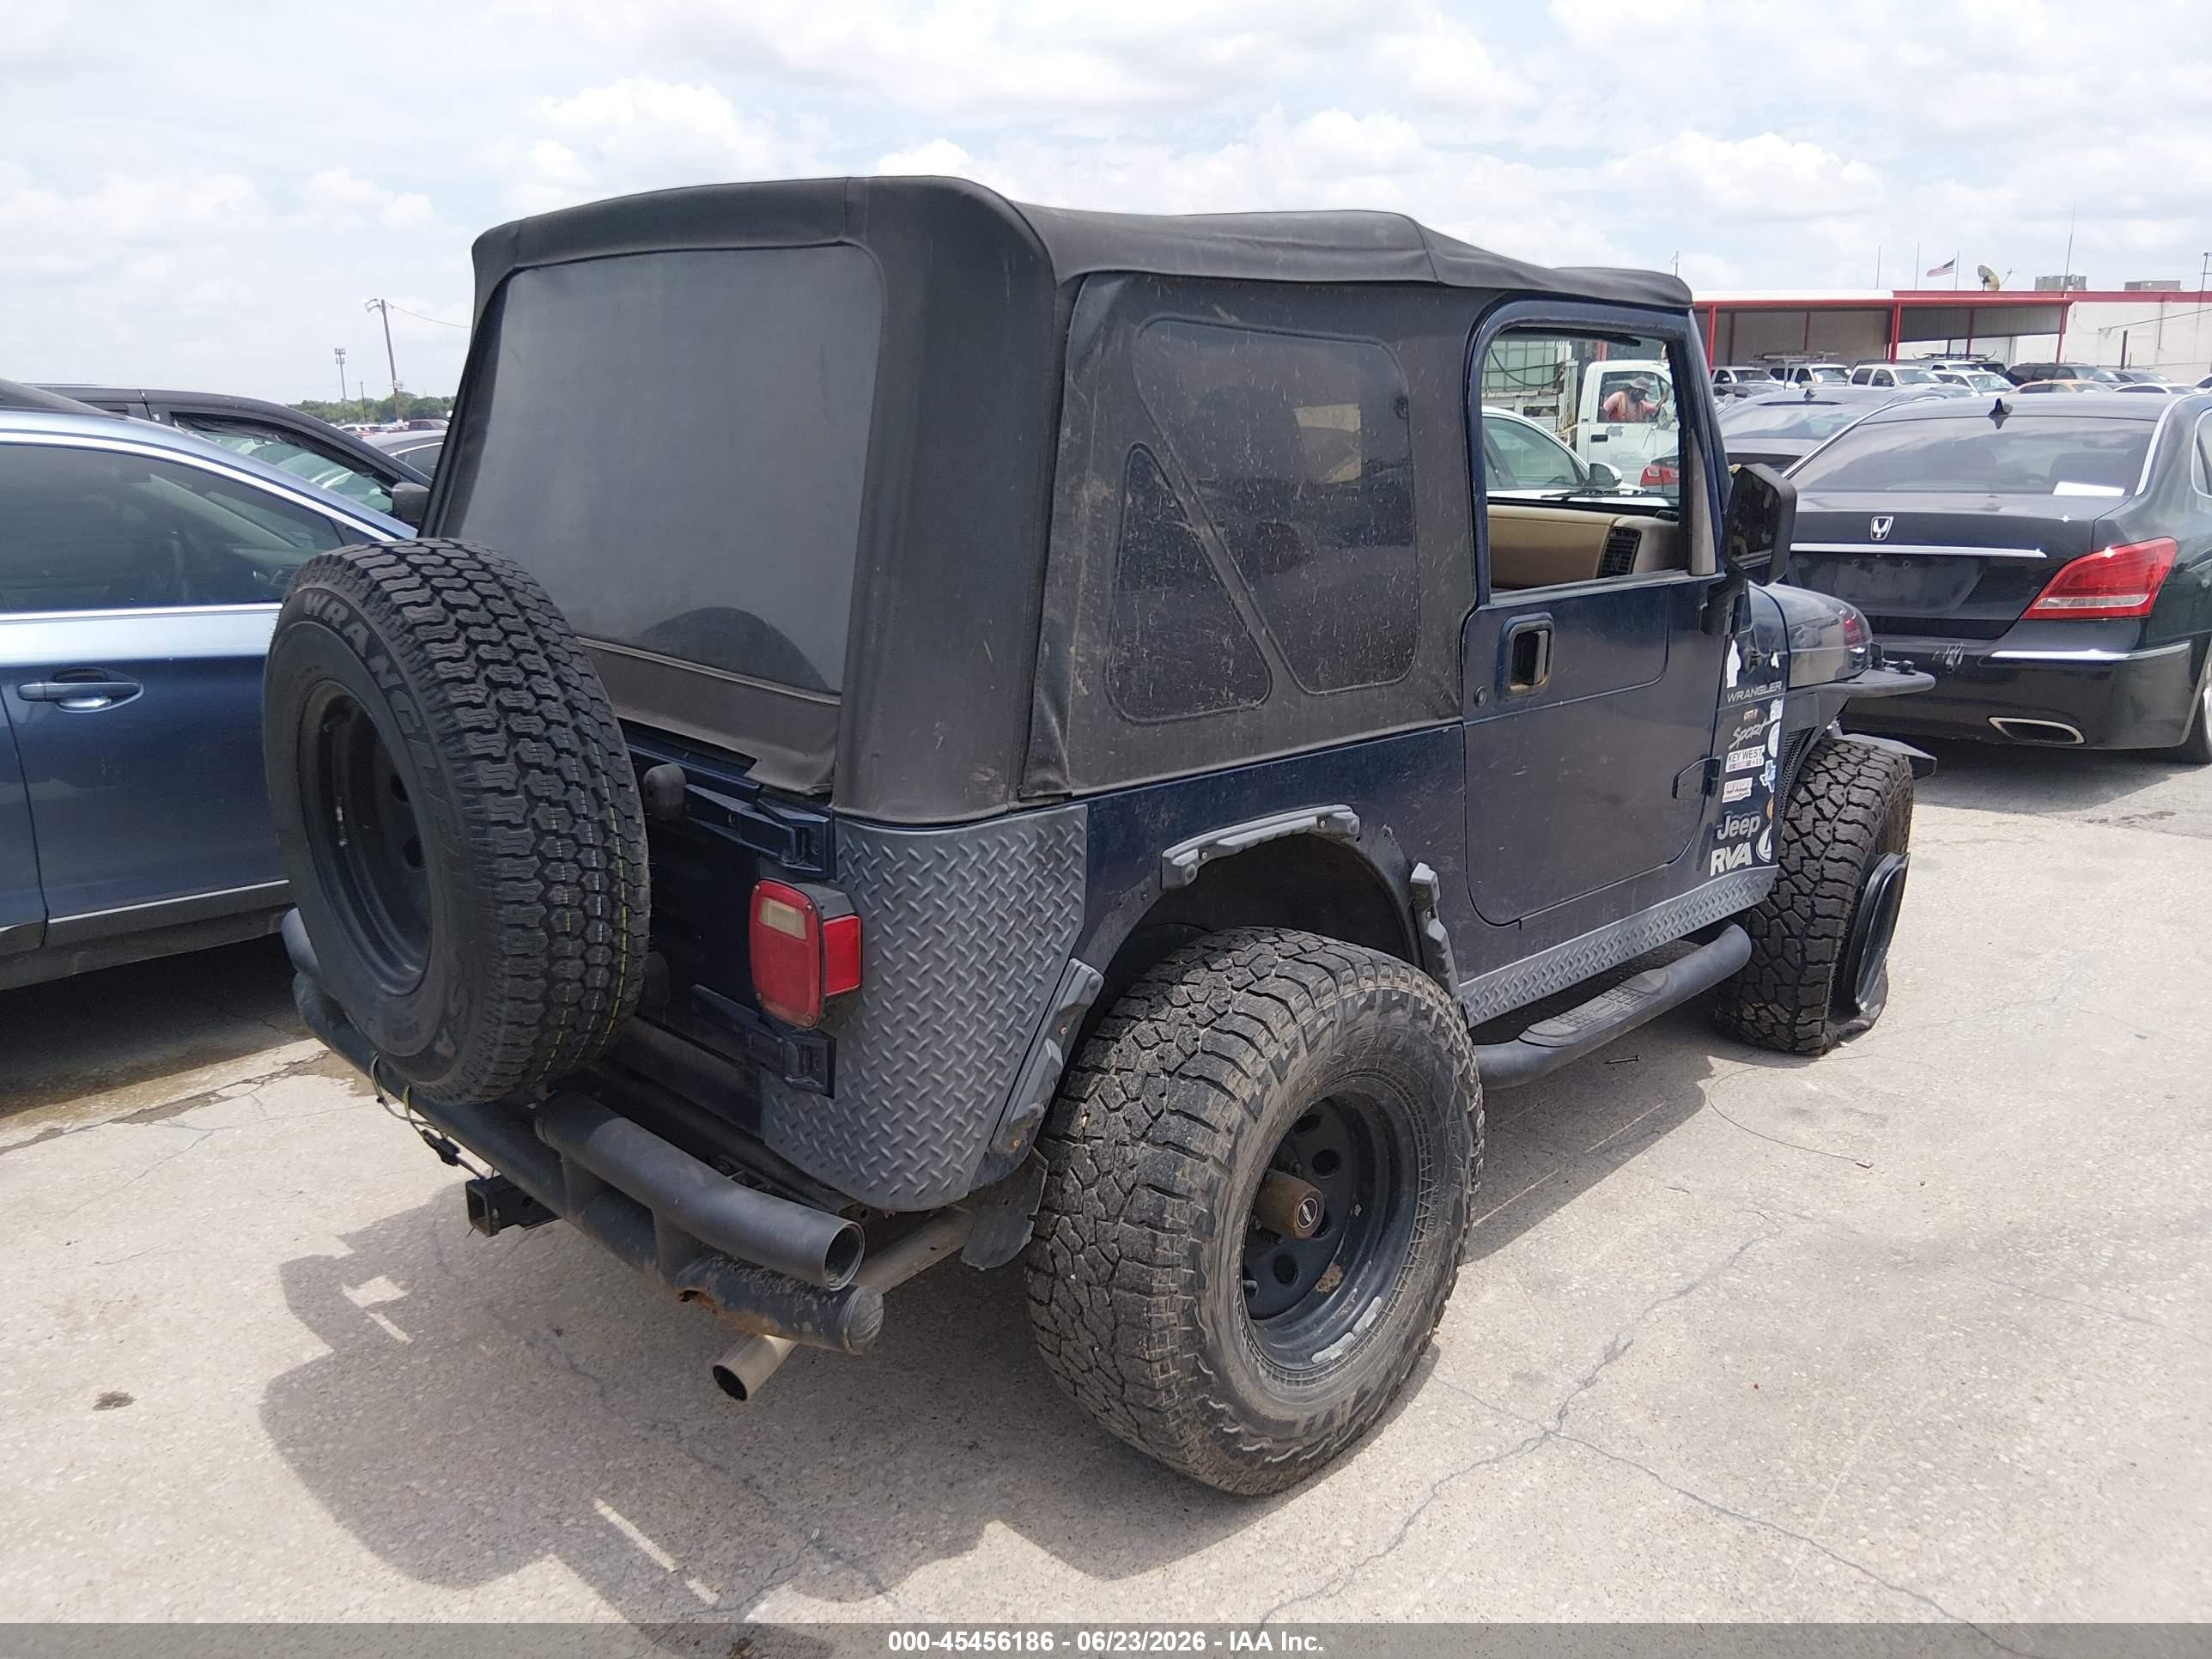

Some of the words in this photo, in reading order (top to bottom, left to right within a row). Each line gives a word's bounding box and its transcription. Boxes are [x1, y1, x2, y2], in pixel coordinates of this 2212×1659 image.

[1727, 680, 1783, 703] WRANGLER
[1728, 750, 1742, 764] KEY
[1742, 747, 1764, 761] WEST
[1717, 814, 1761, 841] Jeep
[1710, 842, 1753, 877] RVA
